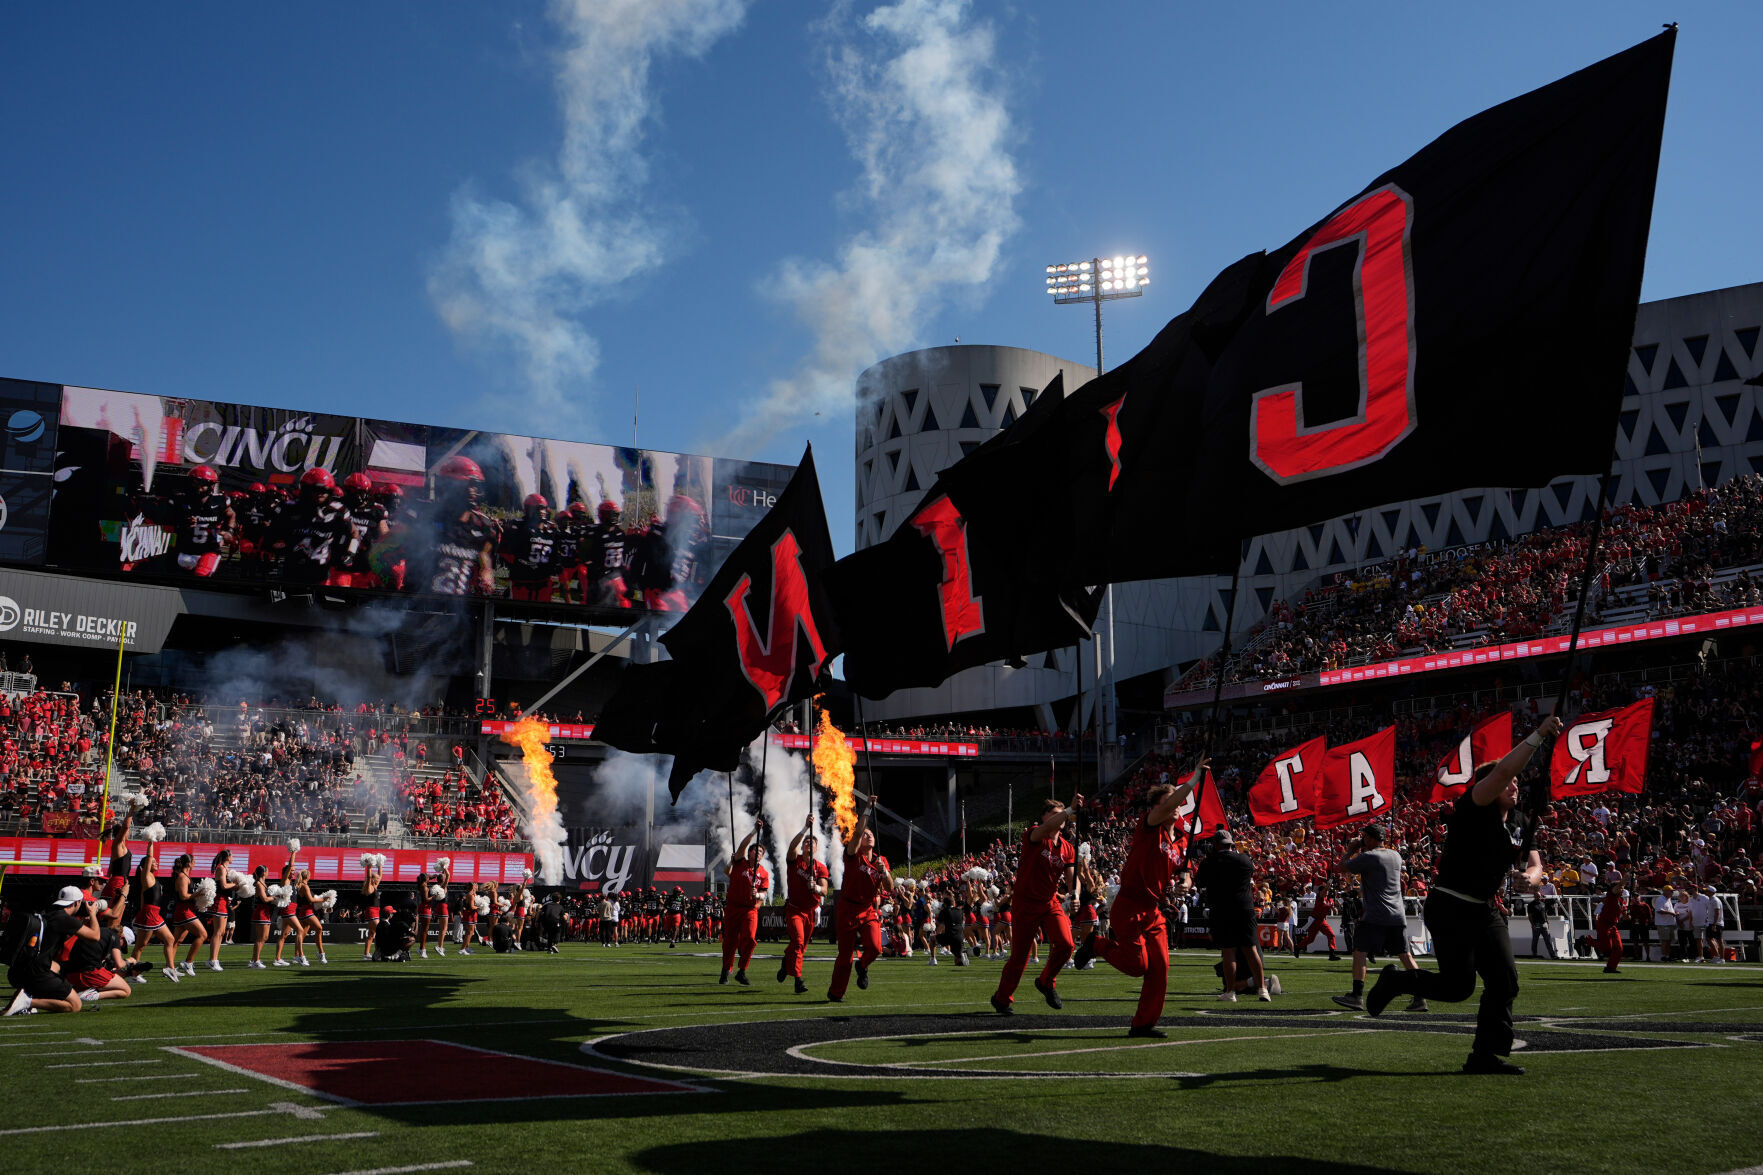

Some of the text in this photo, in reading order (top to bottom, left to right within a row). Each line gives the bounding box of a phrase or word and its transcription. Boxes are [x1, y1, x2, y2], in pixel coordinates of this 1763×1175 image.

[24, 609, 72, 632] RILEY
[23, 626, 55, 635] STAFFING
[475, 699, 495, 714] 25
[1346, 751, 1385, 817] A
[1259, 927, 1272, 942] G
